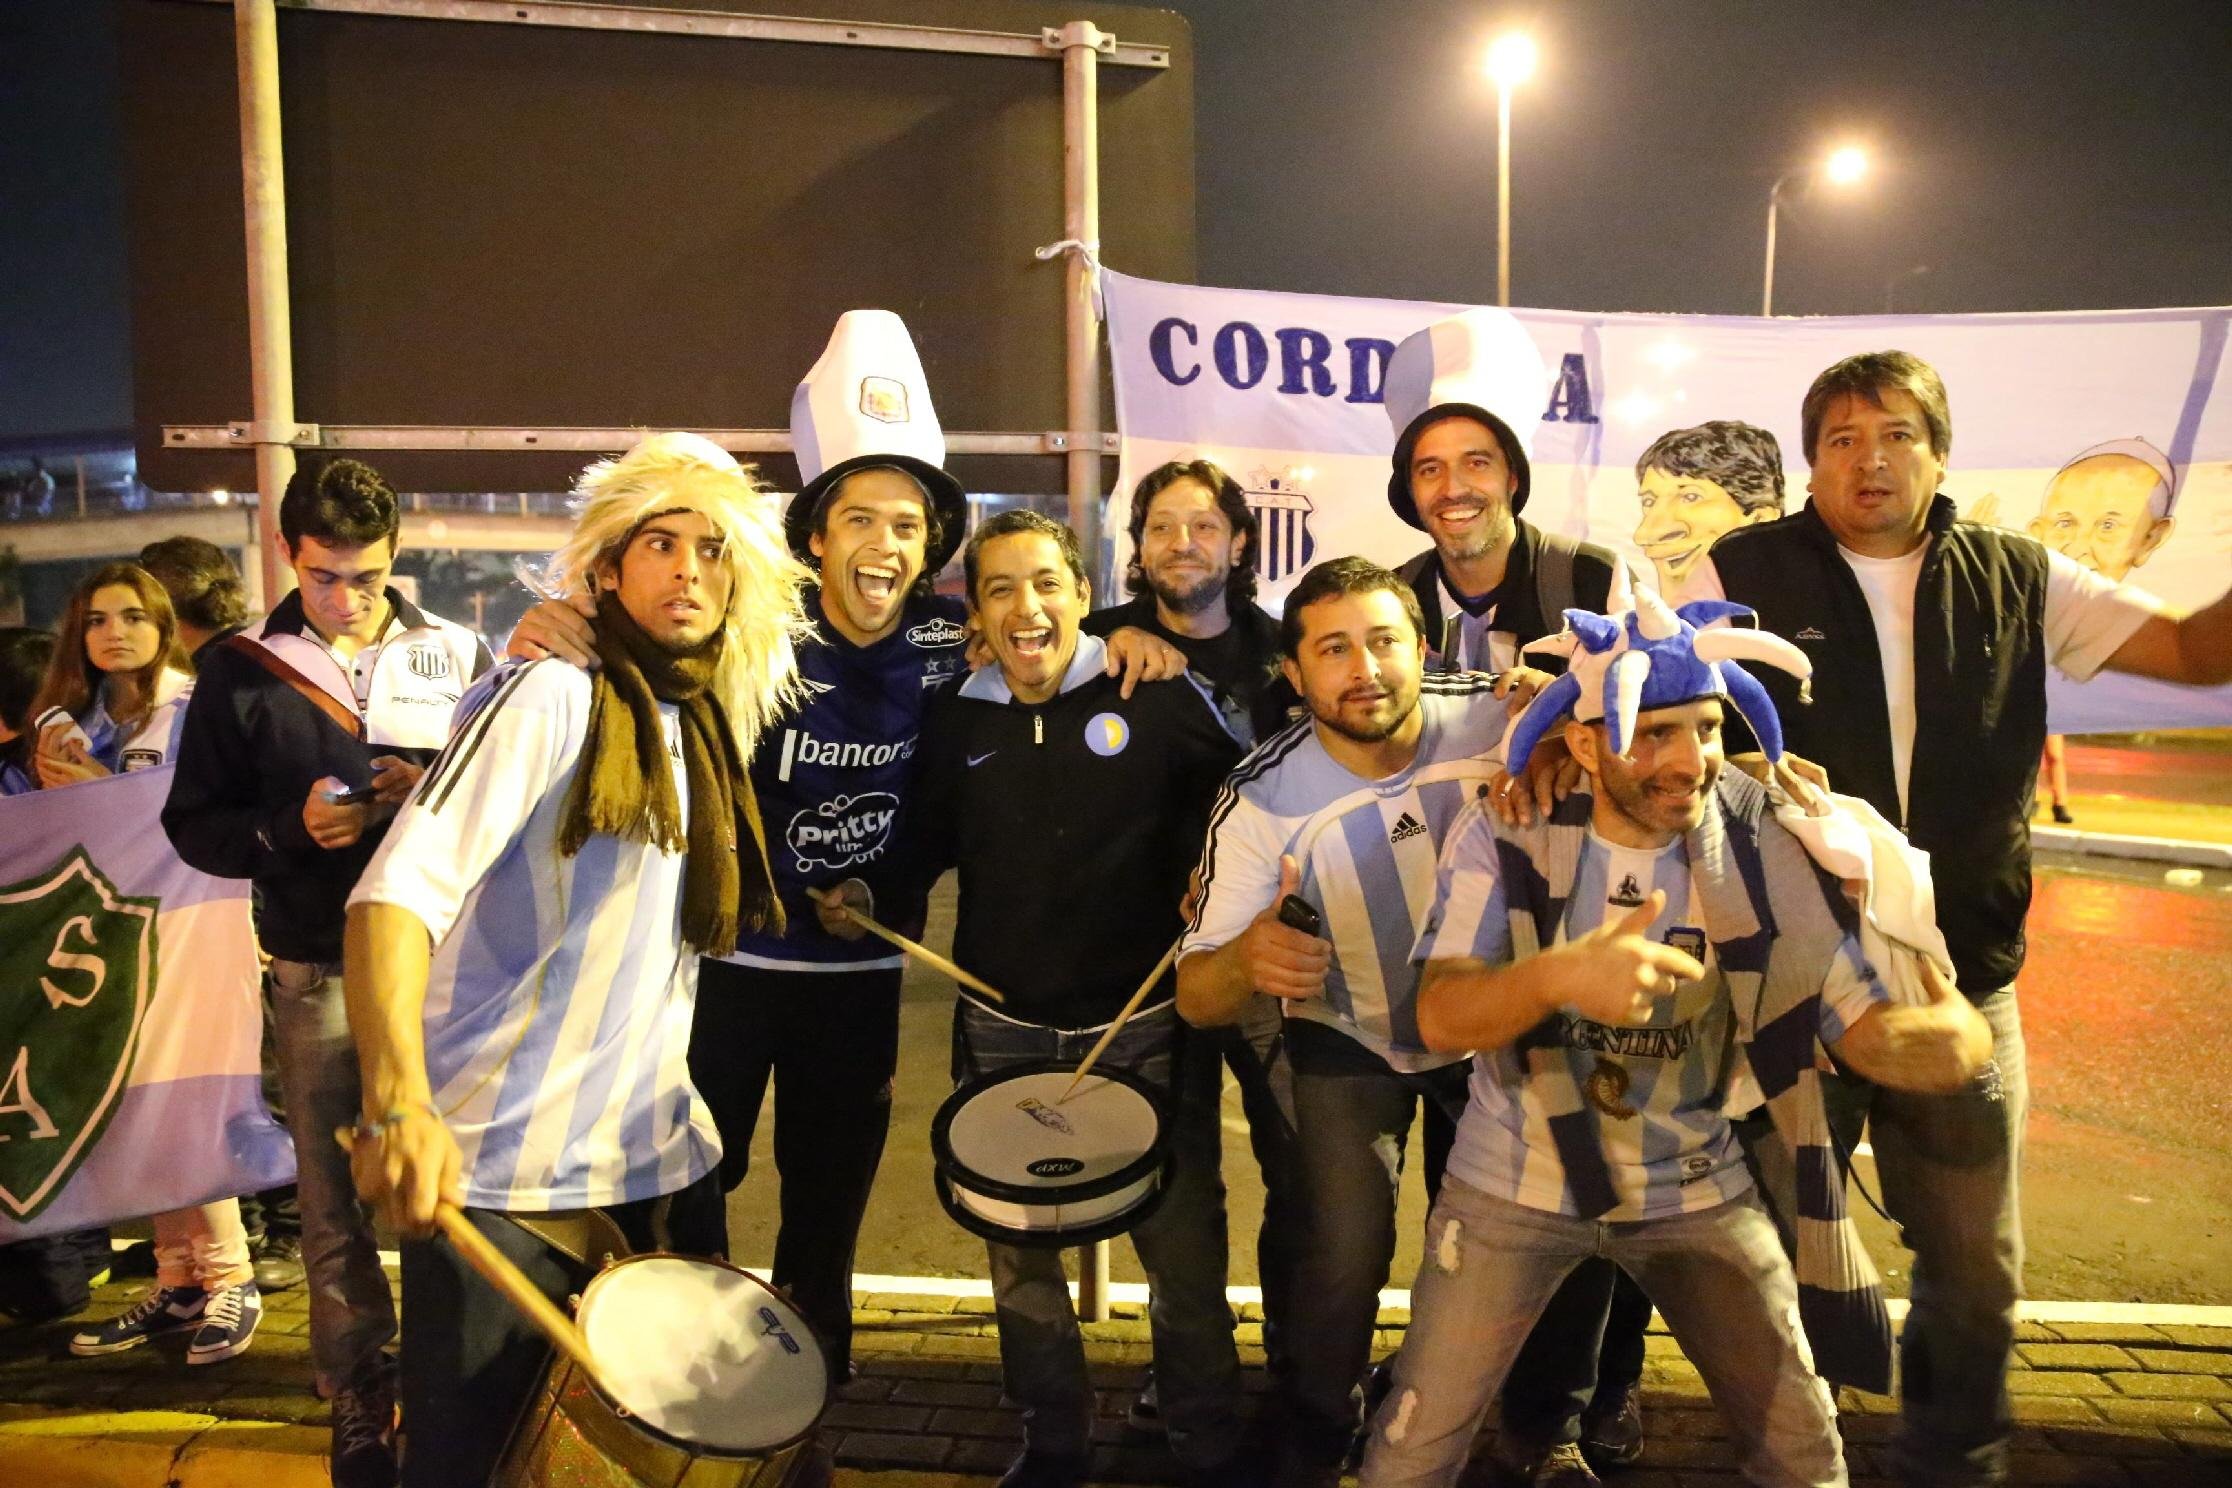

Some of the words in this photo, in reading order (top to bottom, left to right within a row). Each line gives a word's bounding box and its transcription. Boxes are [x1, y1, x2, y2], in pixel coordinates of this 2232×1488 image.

[1149, 317, 1599, 424] CORDA
[911, 627, 964, 643] Sinteplast
[796, 809, 896, 847] Pritty
[1390, 824, 1427, 844] adidas
[39, 914, 107, 1010] S
